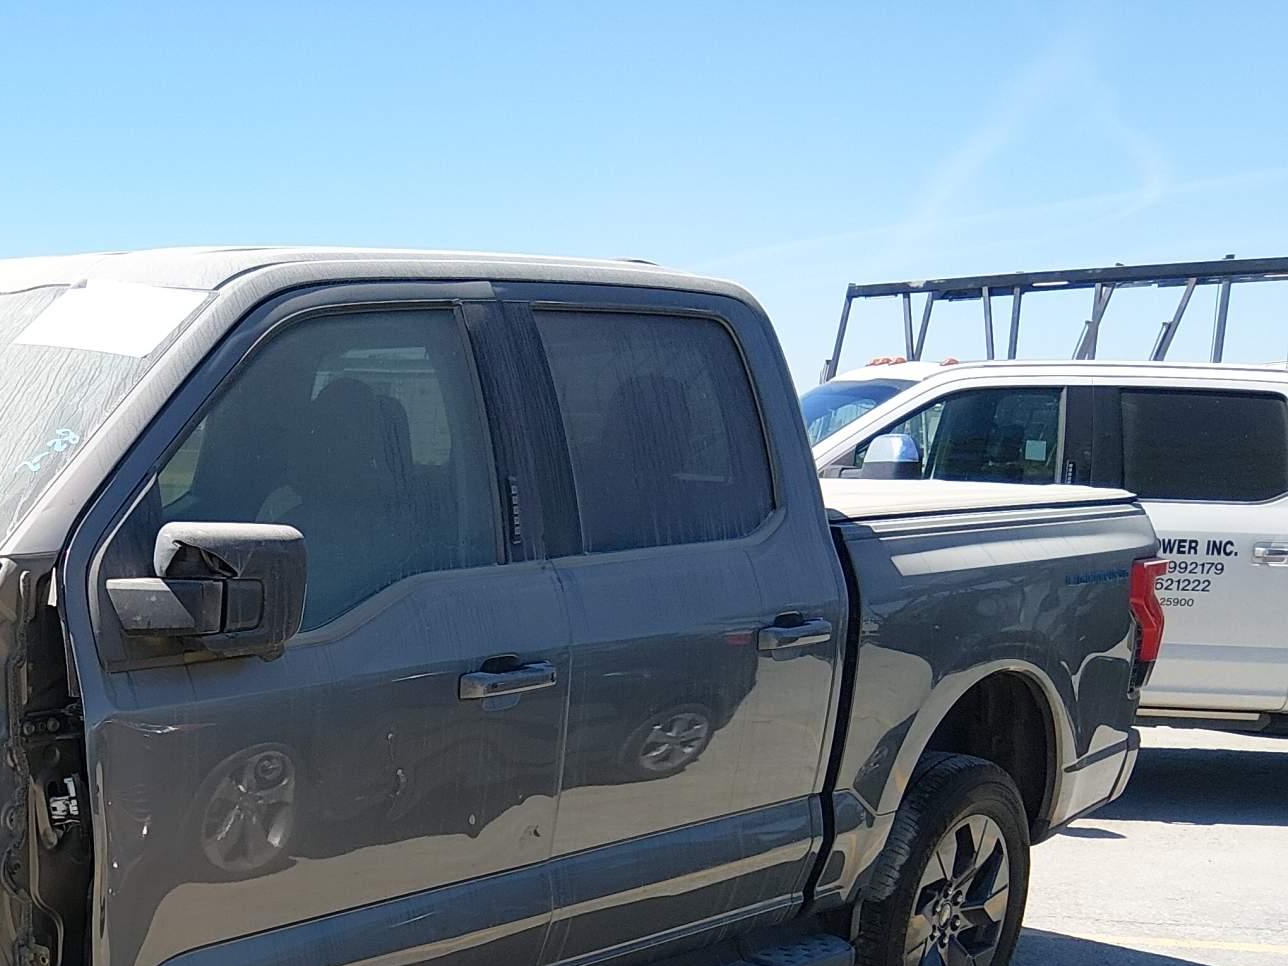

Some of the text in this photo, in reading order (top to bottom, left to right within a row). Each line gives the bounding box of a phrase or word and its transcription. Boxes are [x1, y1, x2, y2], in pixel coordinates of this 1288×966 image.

[1157, 537, 1239, 557] WER INC.
[1167, 560, 1225, 576] 992179
[1154, 577, 1212, 592] 621222
